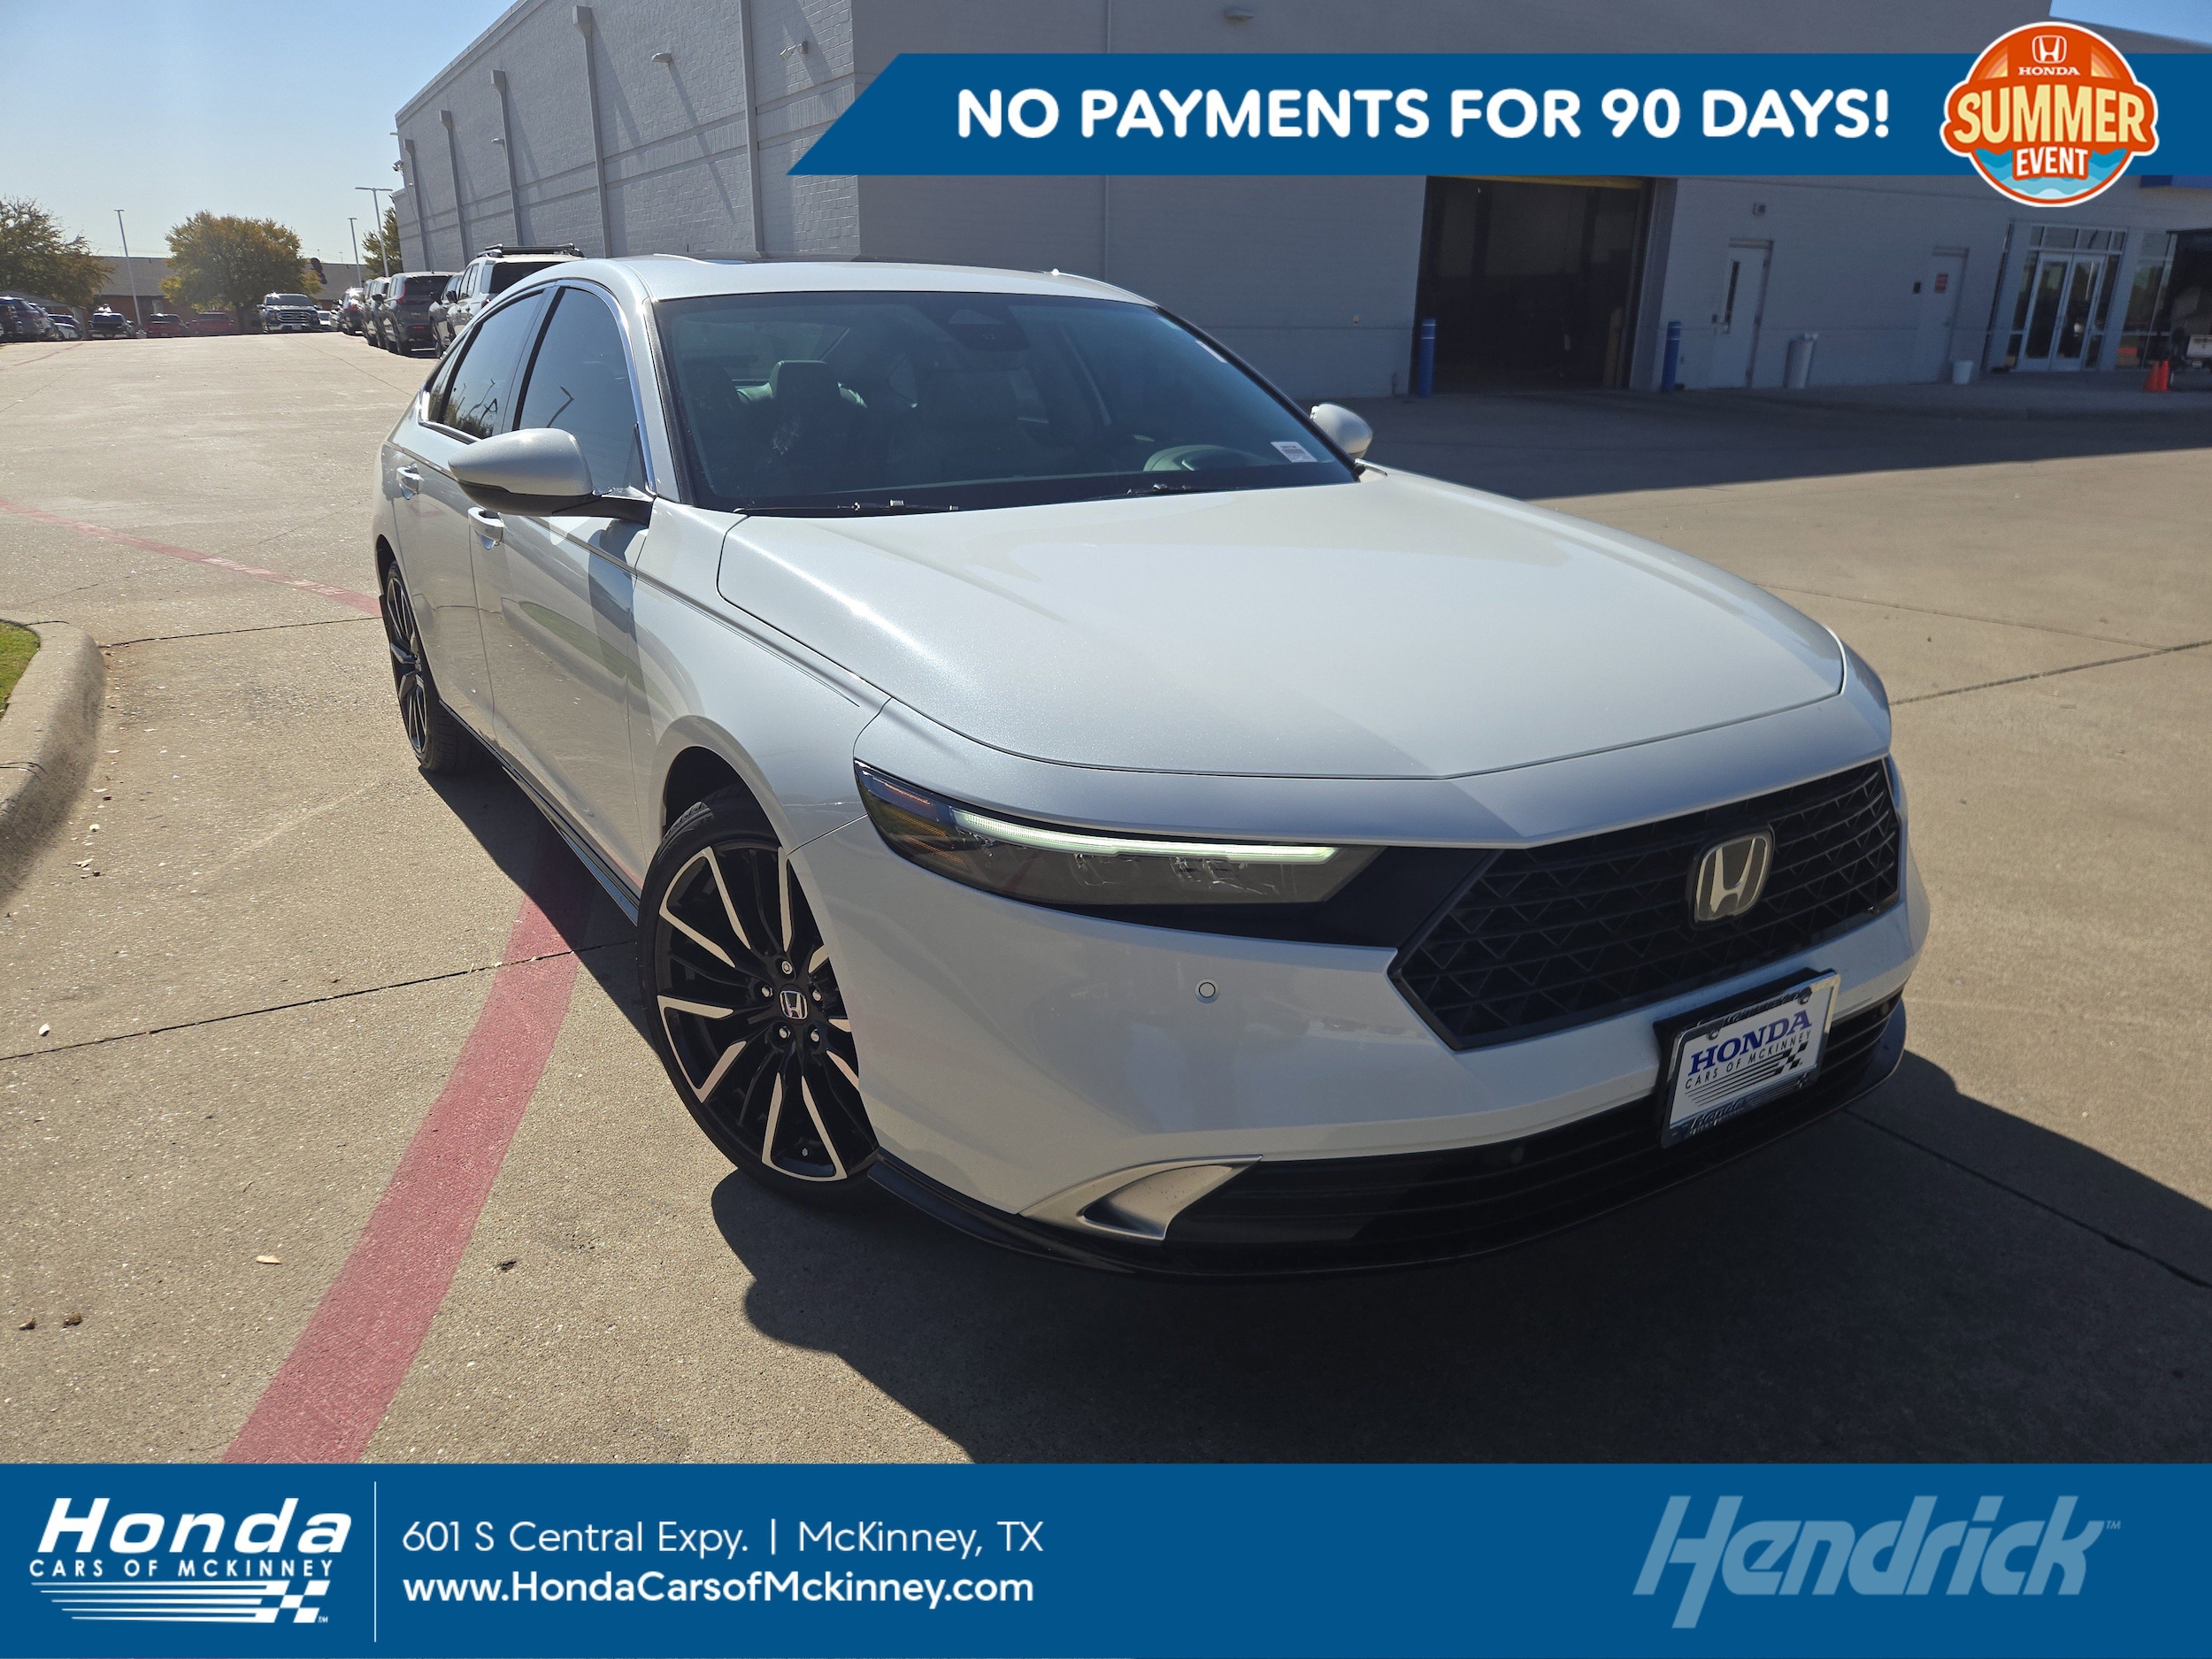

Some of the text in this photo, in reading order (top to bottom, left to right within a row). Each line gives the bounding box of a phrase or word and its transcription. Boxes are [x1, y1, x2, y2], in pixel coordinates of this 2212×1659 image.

[1686, 1030, 1811, 1089] CARS OF MCKINNEY
[1688, 1010, 1811, 1076] HONDA
